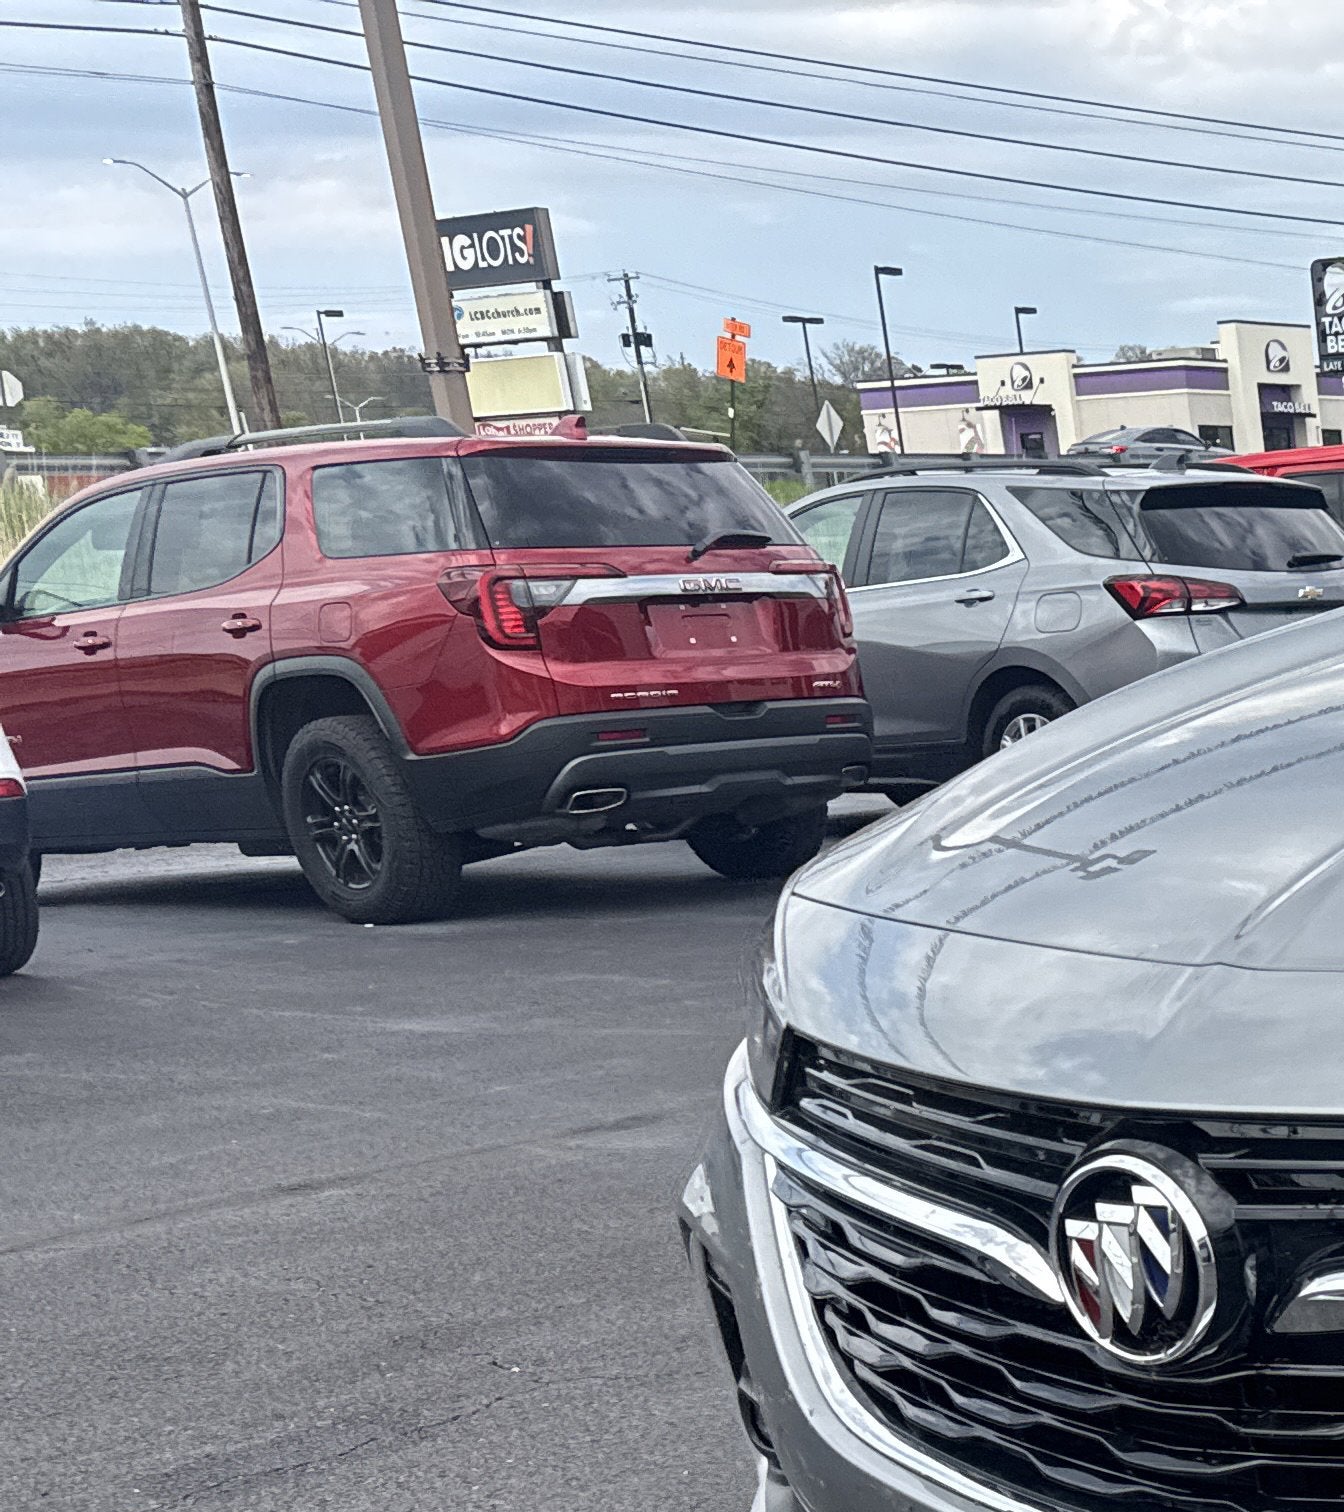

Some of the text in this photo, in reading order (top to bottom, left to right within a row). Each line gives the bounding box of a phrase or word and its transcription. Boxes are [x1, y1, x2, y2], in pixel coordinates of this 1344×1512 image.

[468, 305, 542, 322] LCBCchurch.com
[1323, 361, 1343, 372] LATE
[1272, 401, 1313, 414] TACO BELL
[679, 577, 742, 592] GMC
